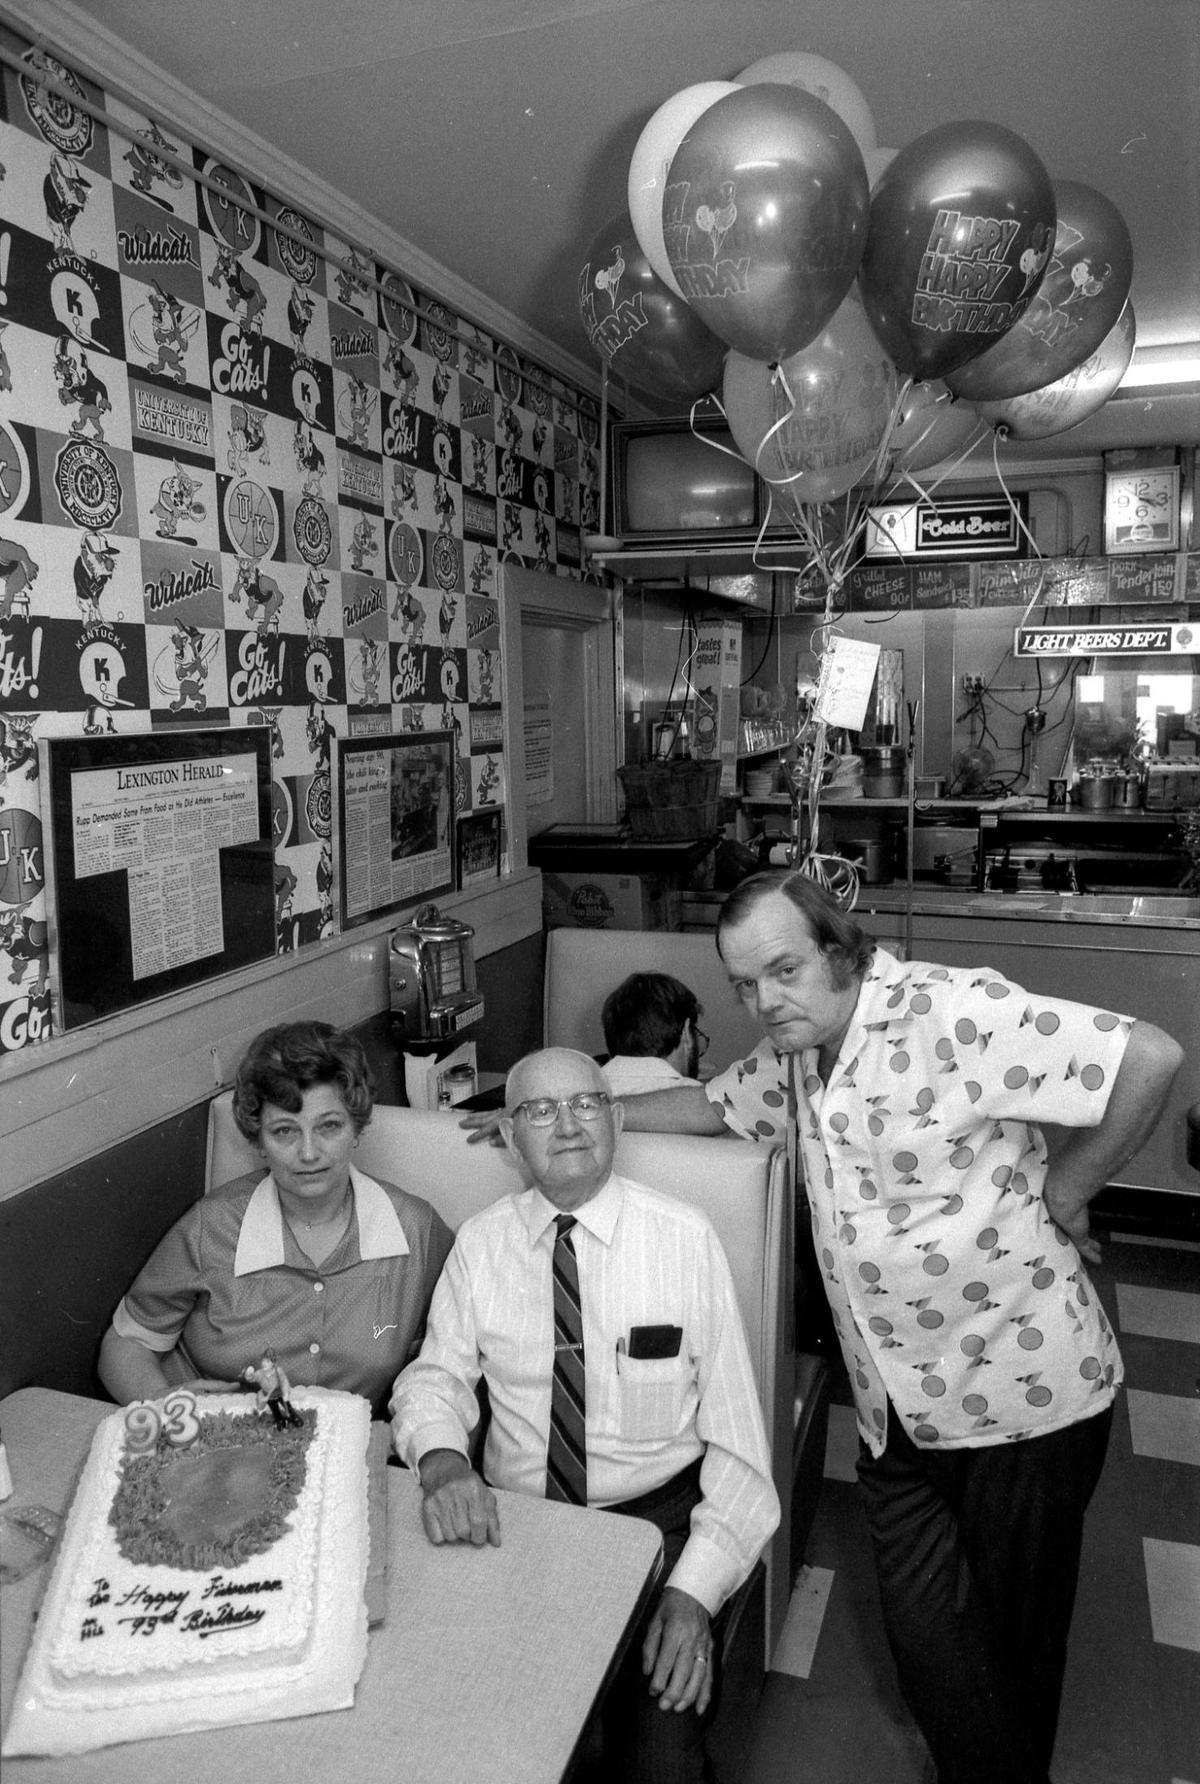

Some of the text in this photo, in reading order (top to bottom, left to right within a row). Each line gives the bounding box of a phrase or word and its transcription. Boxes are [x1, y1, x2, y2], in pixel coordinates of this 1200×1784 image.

[117, 224, 201, 271] Wildcats
[926, 209, 1021, 262] HAPPY
[46, 256, 101, 292] KENTUCKY
[916, 252, 1013, 301] HAPPY
[66, 287, 83, 317] K
[220, 322, 253, 364] Go
[331, 326, 379, 360] Wildcats
[212, 345, 271, 401] Cats!
[137, 408, 209, 447] KENTUCKY
[383, 413, 420, 461] Cats!
[96, 452, 119, 509] KENTUCKY
[1134, 482, 1151, 498] 12
[1134, 505, 1149, 519] 6
[1155, 493, 1170, 507] 3
[237, 493, 269, 546] UK
[922, 515, 1011, 537] Cold Beer
[145, 560, 222, 612] Wildcats
[864, 576, 906, 600] CHEESE
[918, 571, 943, 584] HAM
[75, 628, 127, 651] KENTUCKY
[238, 631, 269, 672] Go
[697, 637, 722, 651] tastes
[1021, 630, 1168, 650] LIGHT BEERS DEPT.
[94, 658, 110, 682] K
[229, 640, 287, 706] Cats!
[313, 663, 323, 684] K
[396, 643, 417, 675] Go
[696, 651, 721, 670] great!
[391, 650, 428, 703] Cats!
[116, 763, 224, 791] LEXINGTON HERALD
[92, 810, 122, 824] Demanded
[123, 807, 139, 818] Same
[140, 804, 153, 815] From
[153, 802, 168, 813] Food
[184, 798, 195, 808] Did
[222, 791, 246, 802] Excellence
[124, 1390, 200, 1451] 93
[114, 1584, 190, 1612] Happy
[180, 1602, 267, 1638] Birthday
